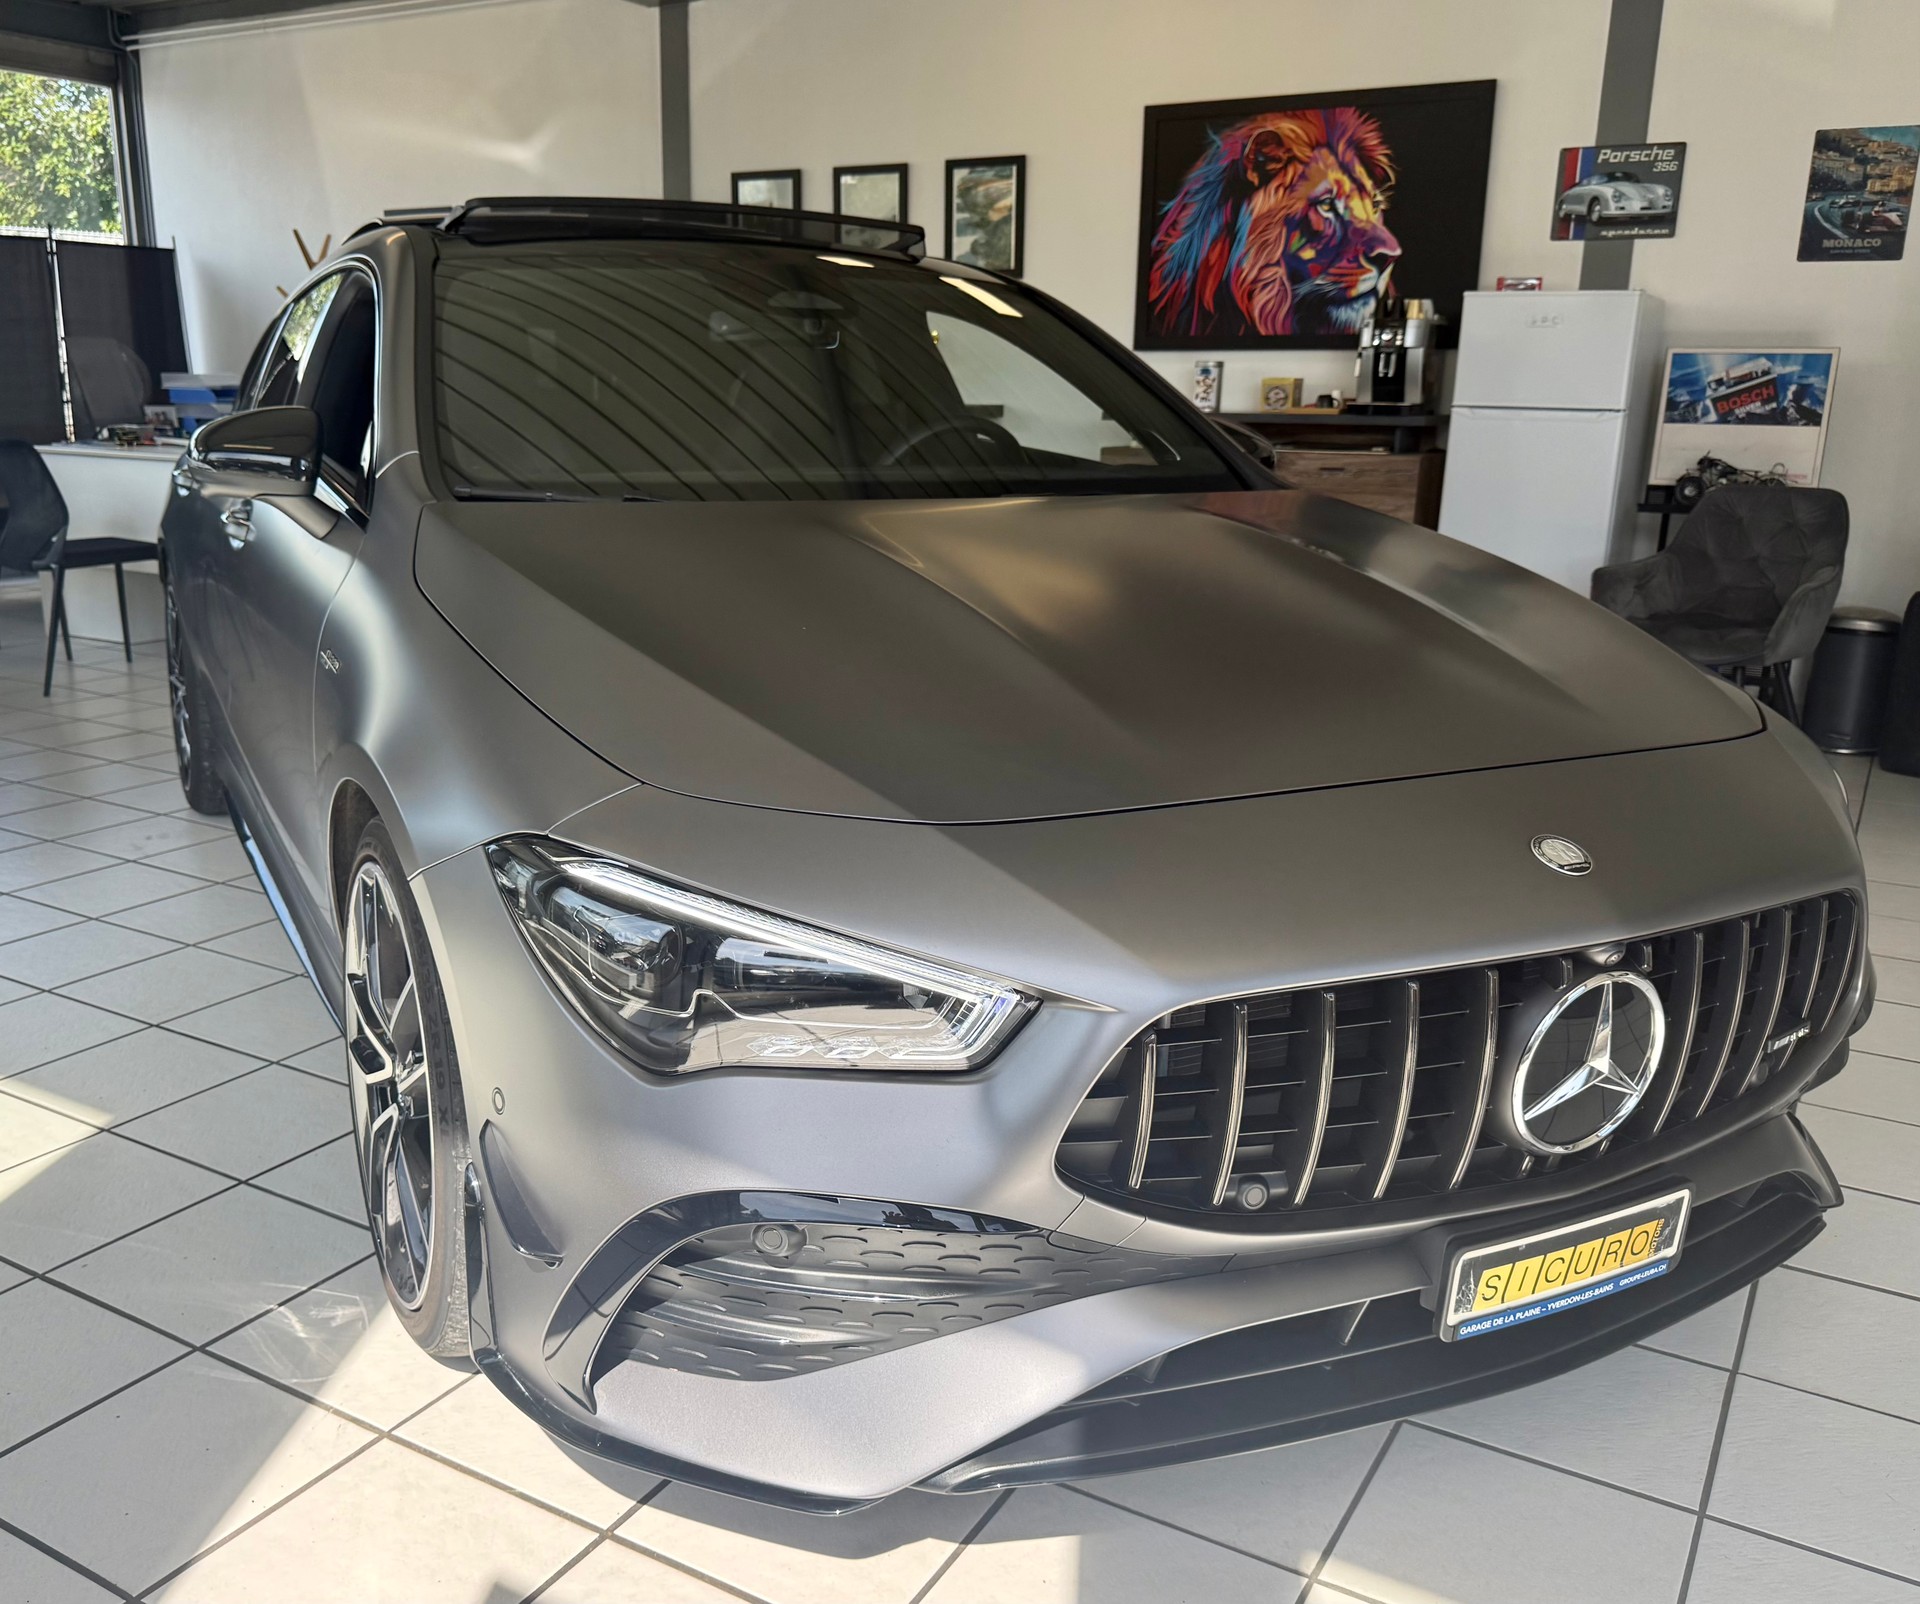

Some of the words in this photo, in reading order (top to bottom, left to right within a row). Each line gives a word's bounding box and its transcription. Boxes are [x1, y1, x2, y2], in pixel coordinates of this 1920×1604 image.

[1597, 145, 1675, 164] Porsche
[1652, 161, 1679, 172] 356
[1822, 238, 1882, 248] MONACO
[1716, 386, 1775, 414] BOSCH
[1648, 1218, 1665, 1258] MOTORS
[1482, 1229, 1650, 1301] SICURO
[1460, 1320, 1492, 1335] GARAGE
[1493, 1316, 1504, 1326] DE
[1504, 1314, 1514, 1323] LA
[1515, 1306, 1541, 1321] PLAINE
[1547, 1283, 1614, 1311] YVERDON-LES-BAINS
